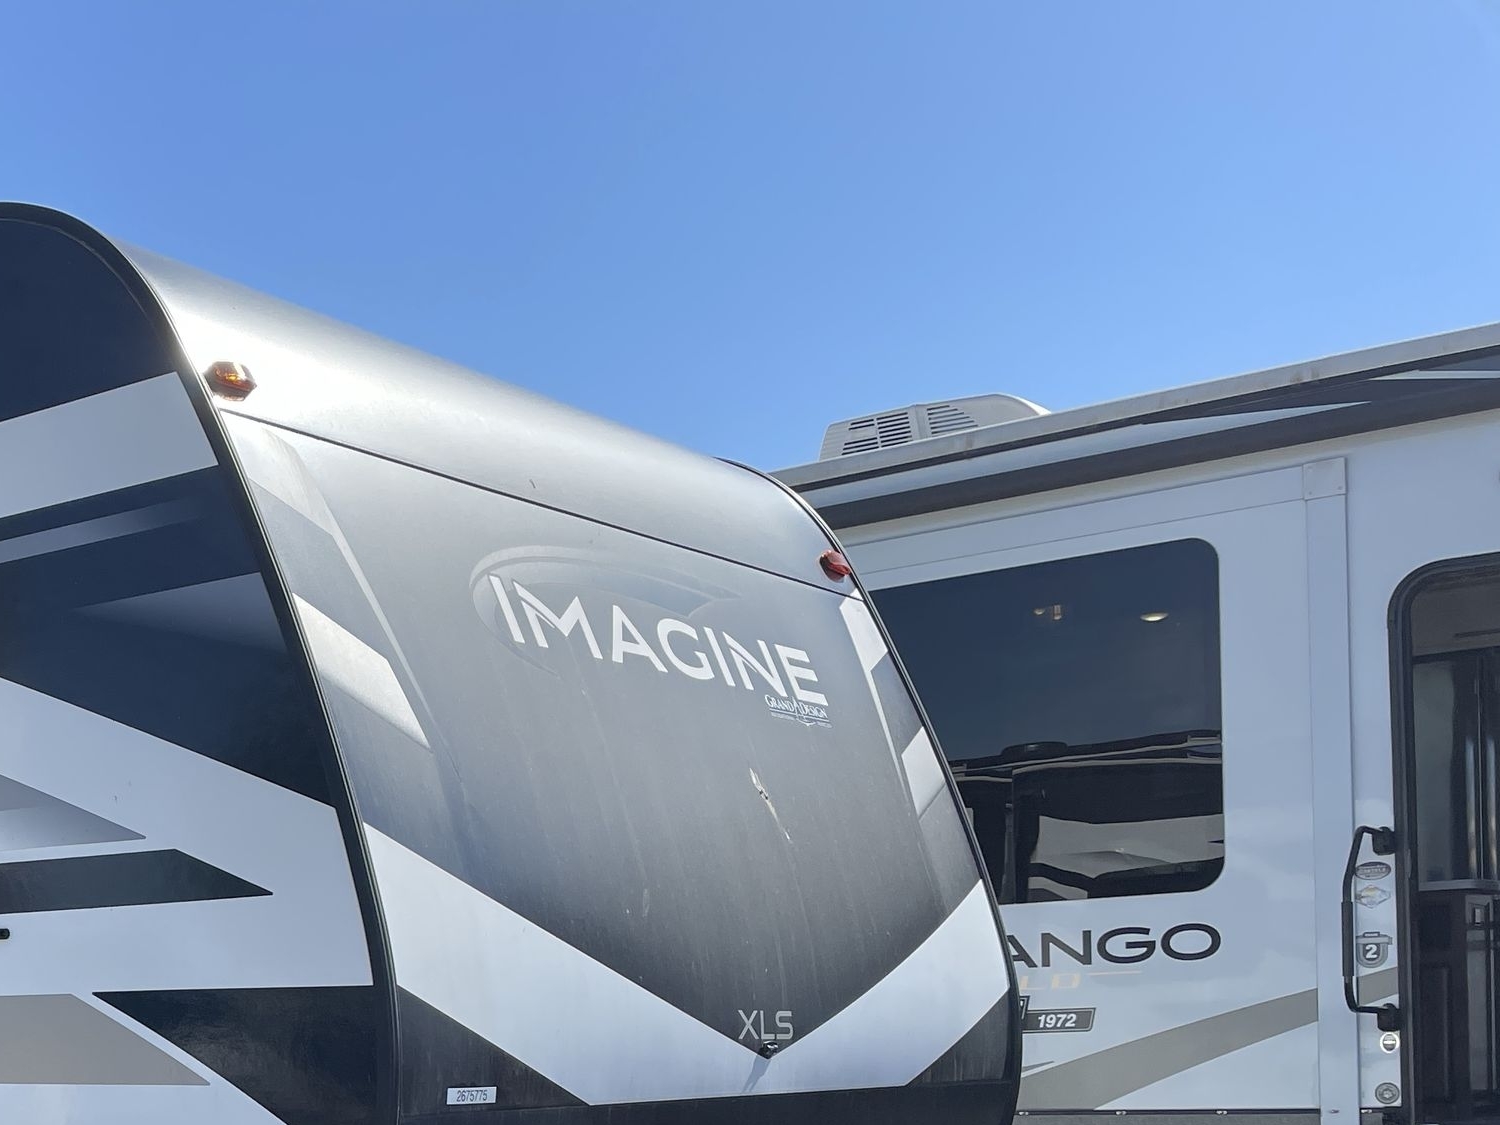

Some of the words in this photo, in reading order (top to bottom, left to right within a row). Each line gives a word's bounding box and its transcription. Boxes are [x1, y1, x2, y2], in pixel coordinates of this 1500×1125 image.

[488, 574, 829, 706] IMAGINE
[1006, 923, 1221, 968] ANGO
[1365, 944, 1378, 959] 2
[737, 1009, 794, 1040] XLS
[1038, 1014, 1077, 1029] 1972
[456, 1089, 488, 1102] 2675775
